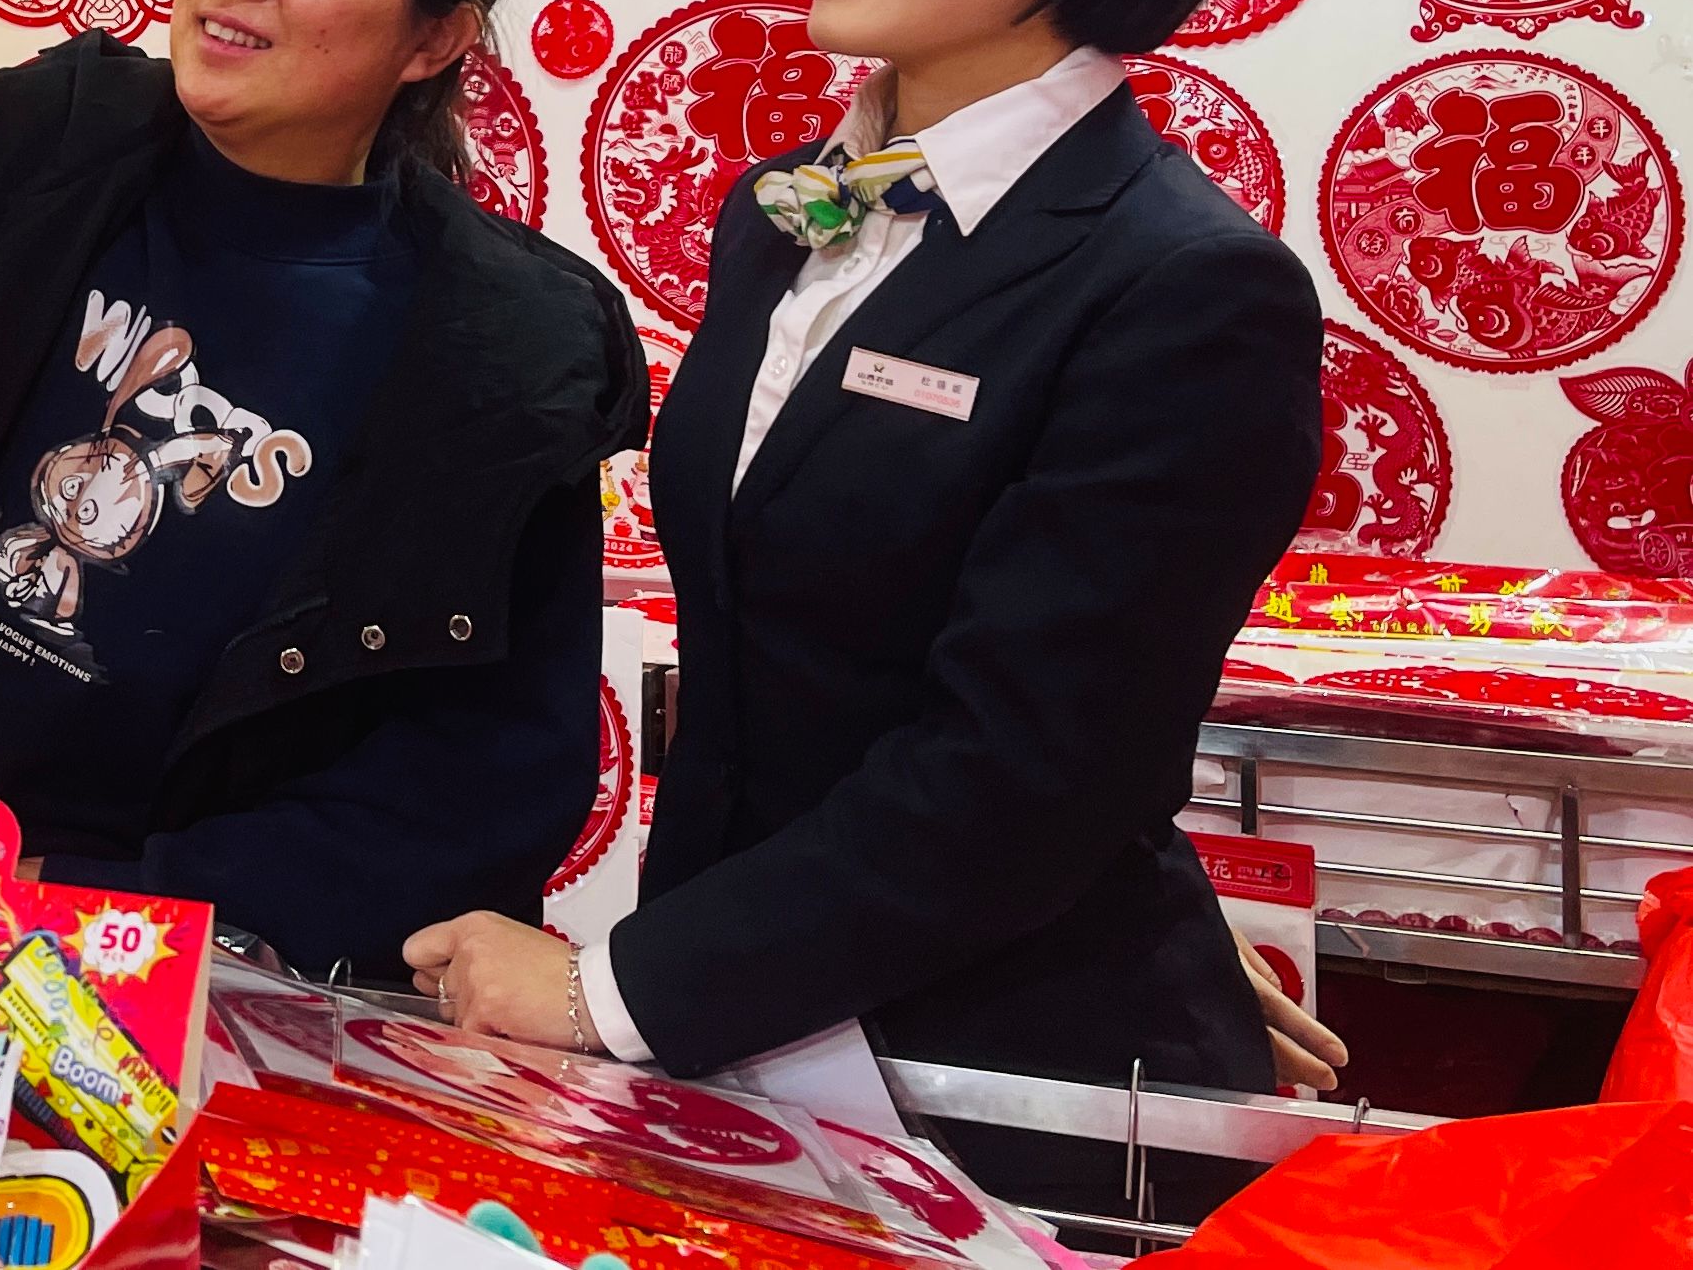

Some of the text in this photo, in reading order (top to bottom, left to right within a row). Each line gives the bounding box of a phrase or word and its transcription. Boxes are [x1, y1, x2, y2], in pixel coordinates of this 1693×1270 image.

[1411, 90, 1587, 234] 福
[603, 539, 634, 554] 2024
[34, 644, 92, 683] EMOTIONS
[99, 922, 142, 953] 50
[53, 1045, 122, 1105] Boom
